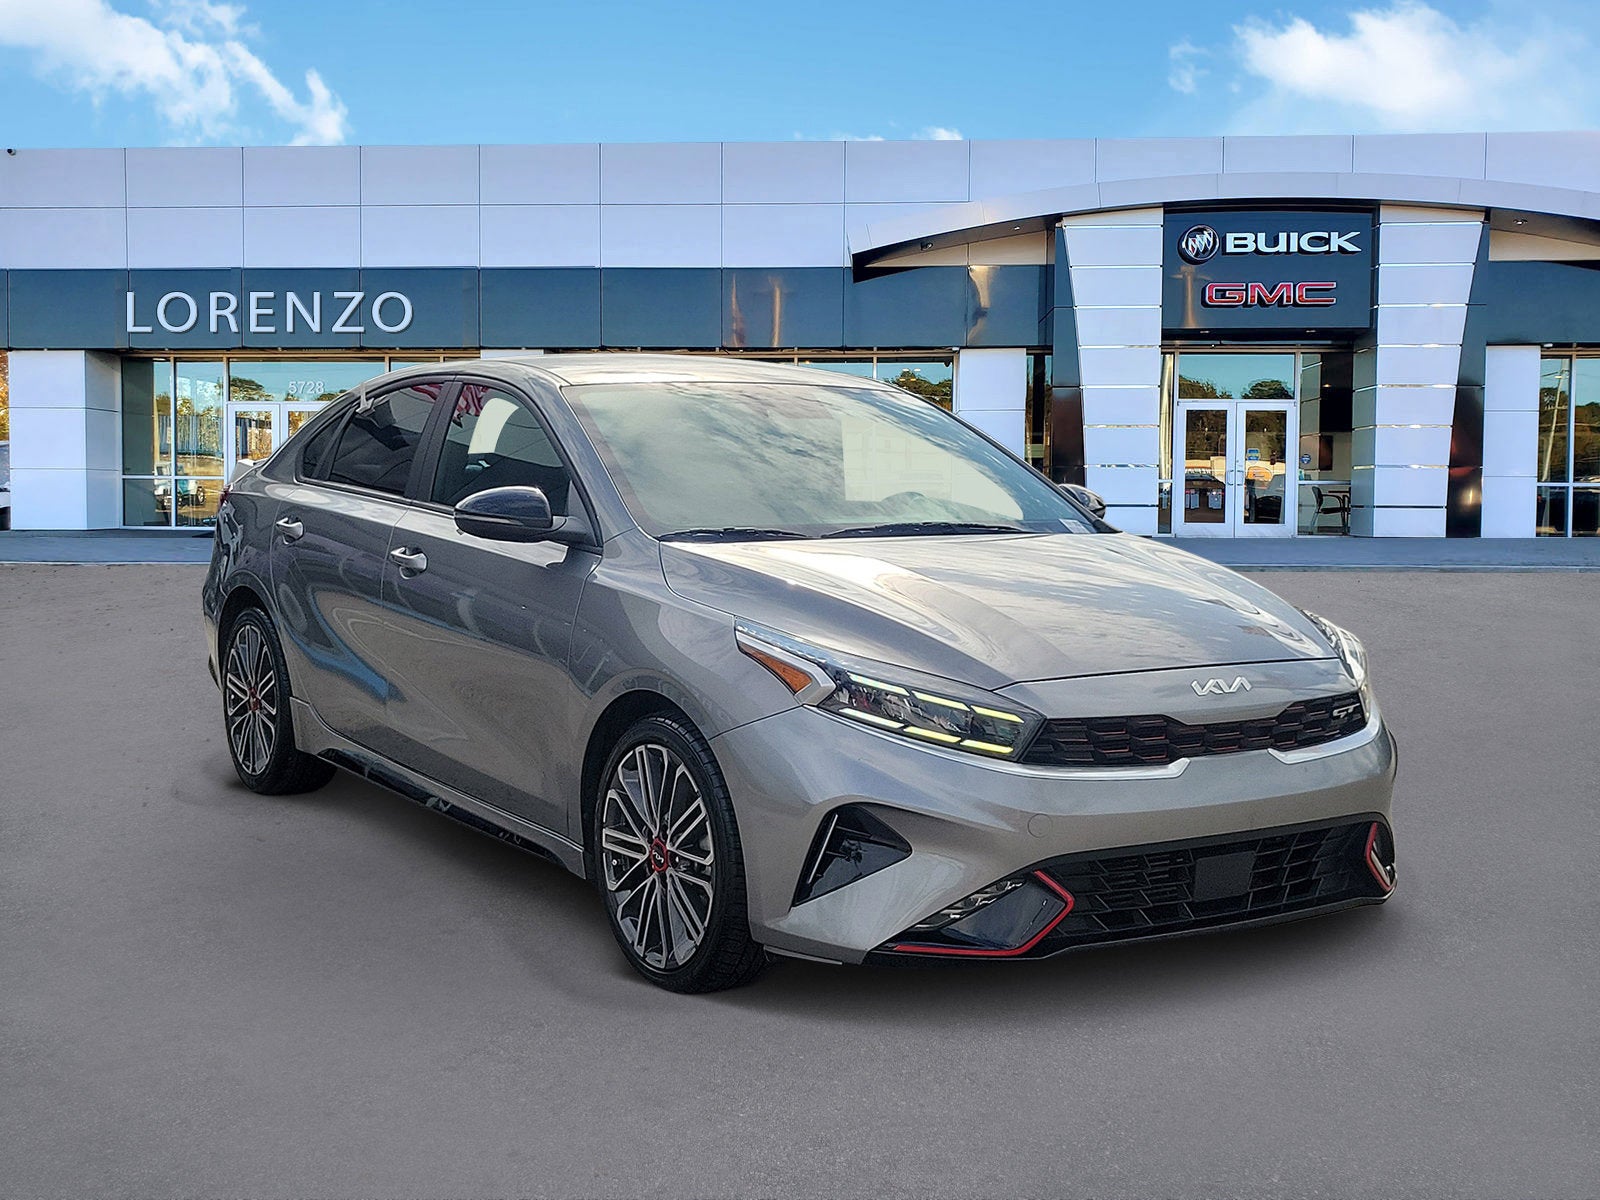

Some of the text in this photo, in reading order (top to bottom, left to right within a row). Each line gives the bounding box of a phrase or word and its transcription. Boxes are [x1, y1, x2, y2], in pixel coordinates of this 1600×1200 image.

[1225, 231, 1362, 253] BUICK
[1205, 281, 1337, 305] GMC
[126, 291, 414, 333] LORENZO
[288, 380, 325, 394] 5728
[1191, 676, 1252, 696] KIA
[1332, 702, 1361, 718] GT
